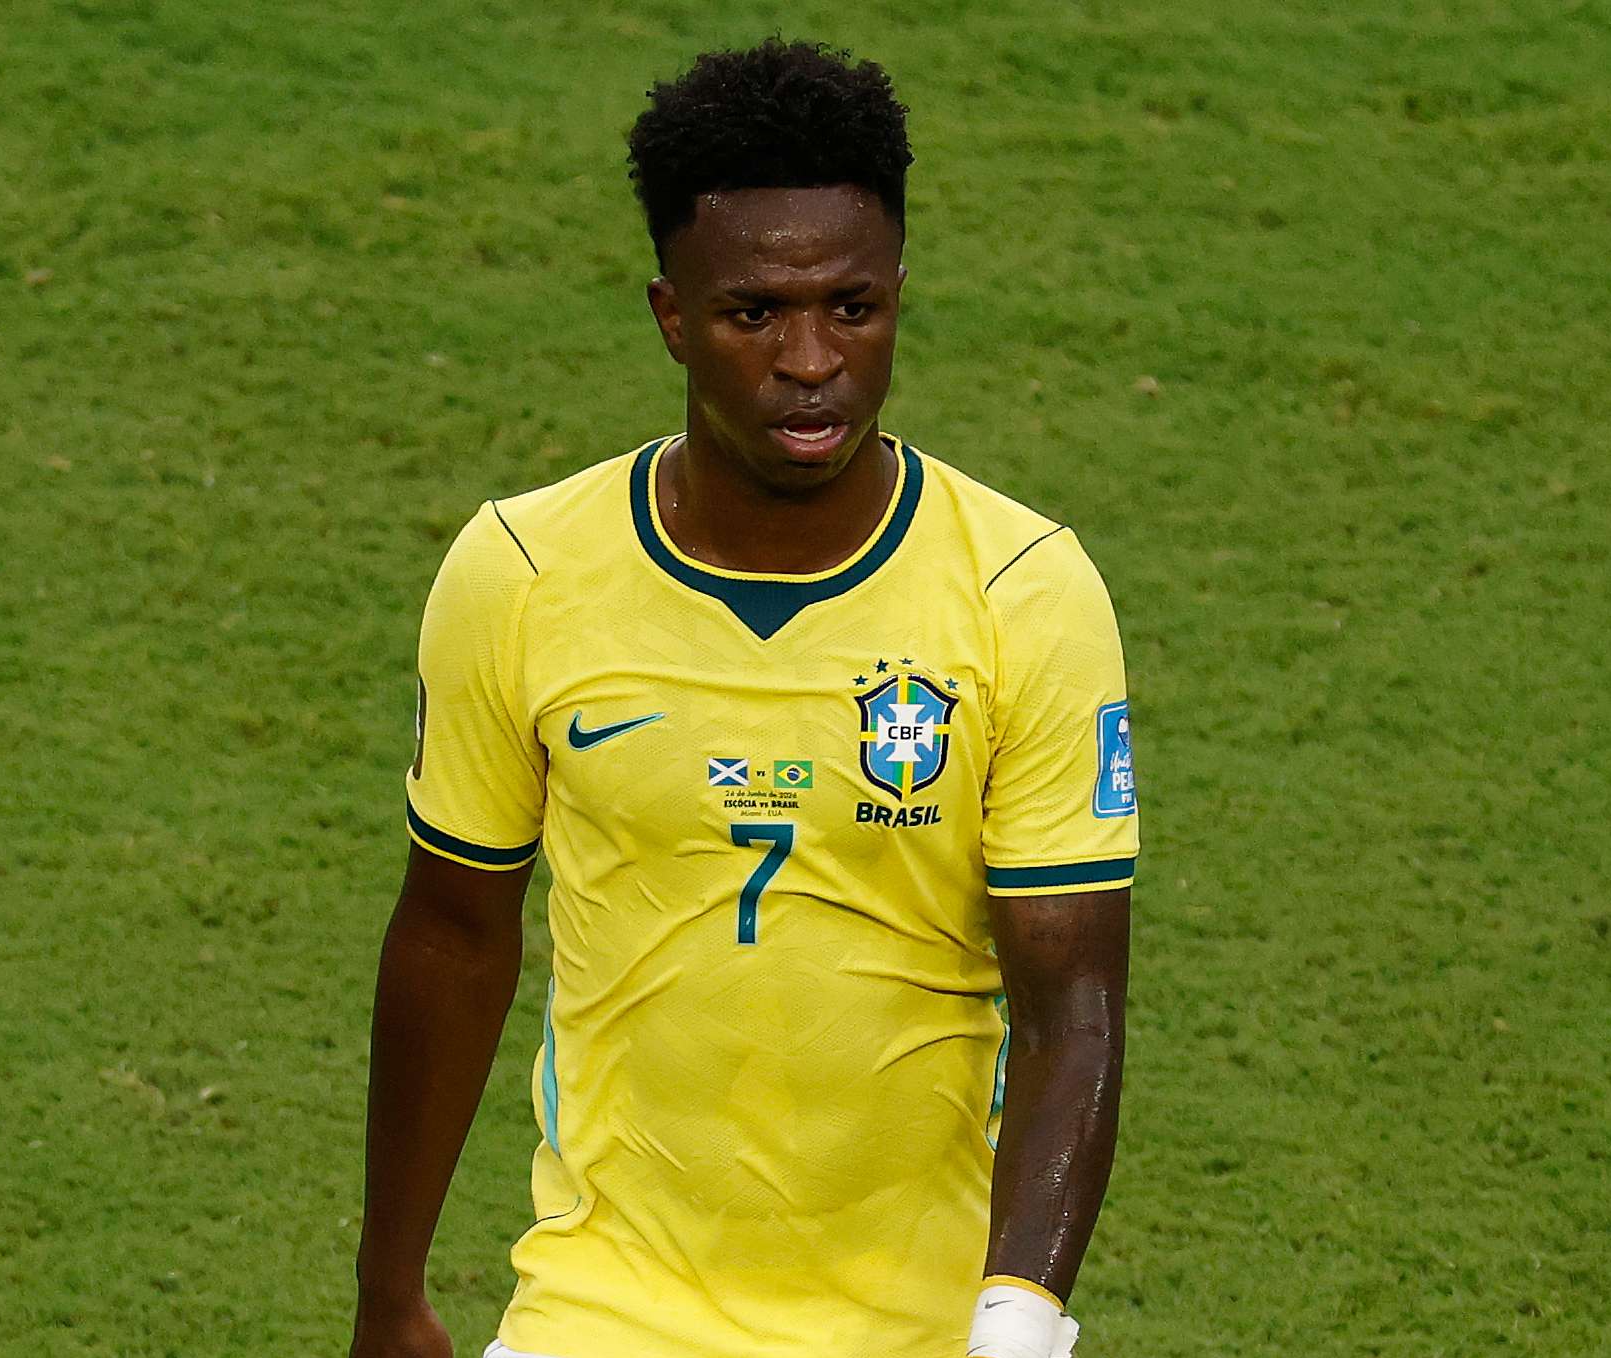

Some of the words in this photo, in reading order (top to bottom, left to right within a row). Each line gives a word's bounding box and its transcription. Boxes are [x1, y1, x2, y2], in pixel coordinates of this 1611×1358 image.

[888, 726, 923, 740] CBF
[771, 800, 799, 809] BRASIL
[856, 802, 943, 828] BRASIL
[730, 823, 795, 944] 7
